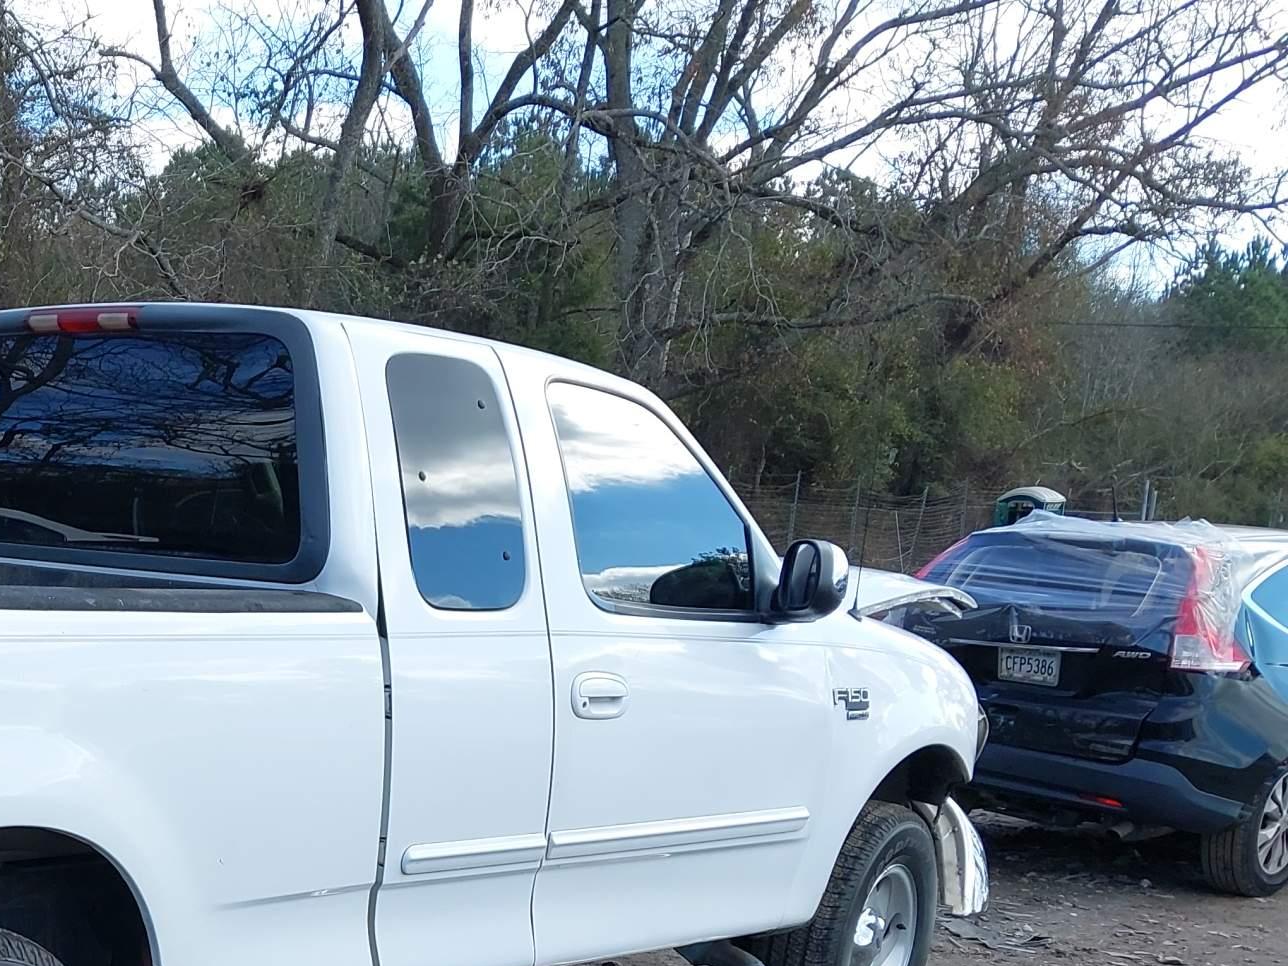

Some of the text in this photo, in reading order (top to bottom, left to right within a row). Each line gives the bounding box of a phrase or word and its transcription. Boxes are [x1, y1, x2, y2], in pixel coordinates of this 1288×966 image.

[1113, 650, 1152, 659] AWD
[1005, 655, 1054, 676] CFP5386
[832, 687, 870, 705] F150
